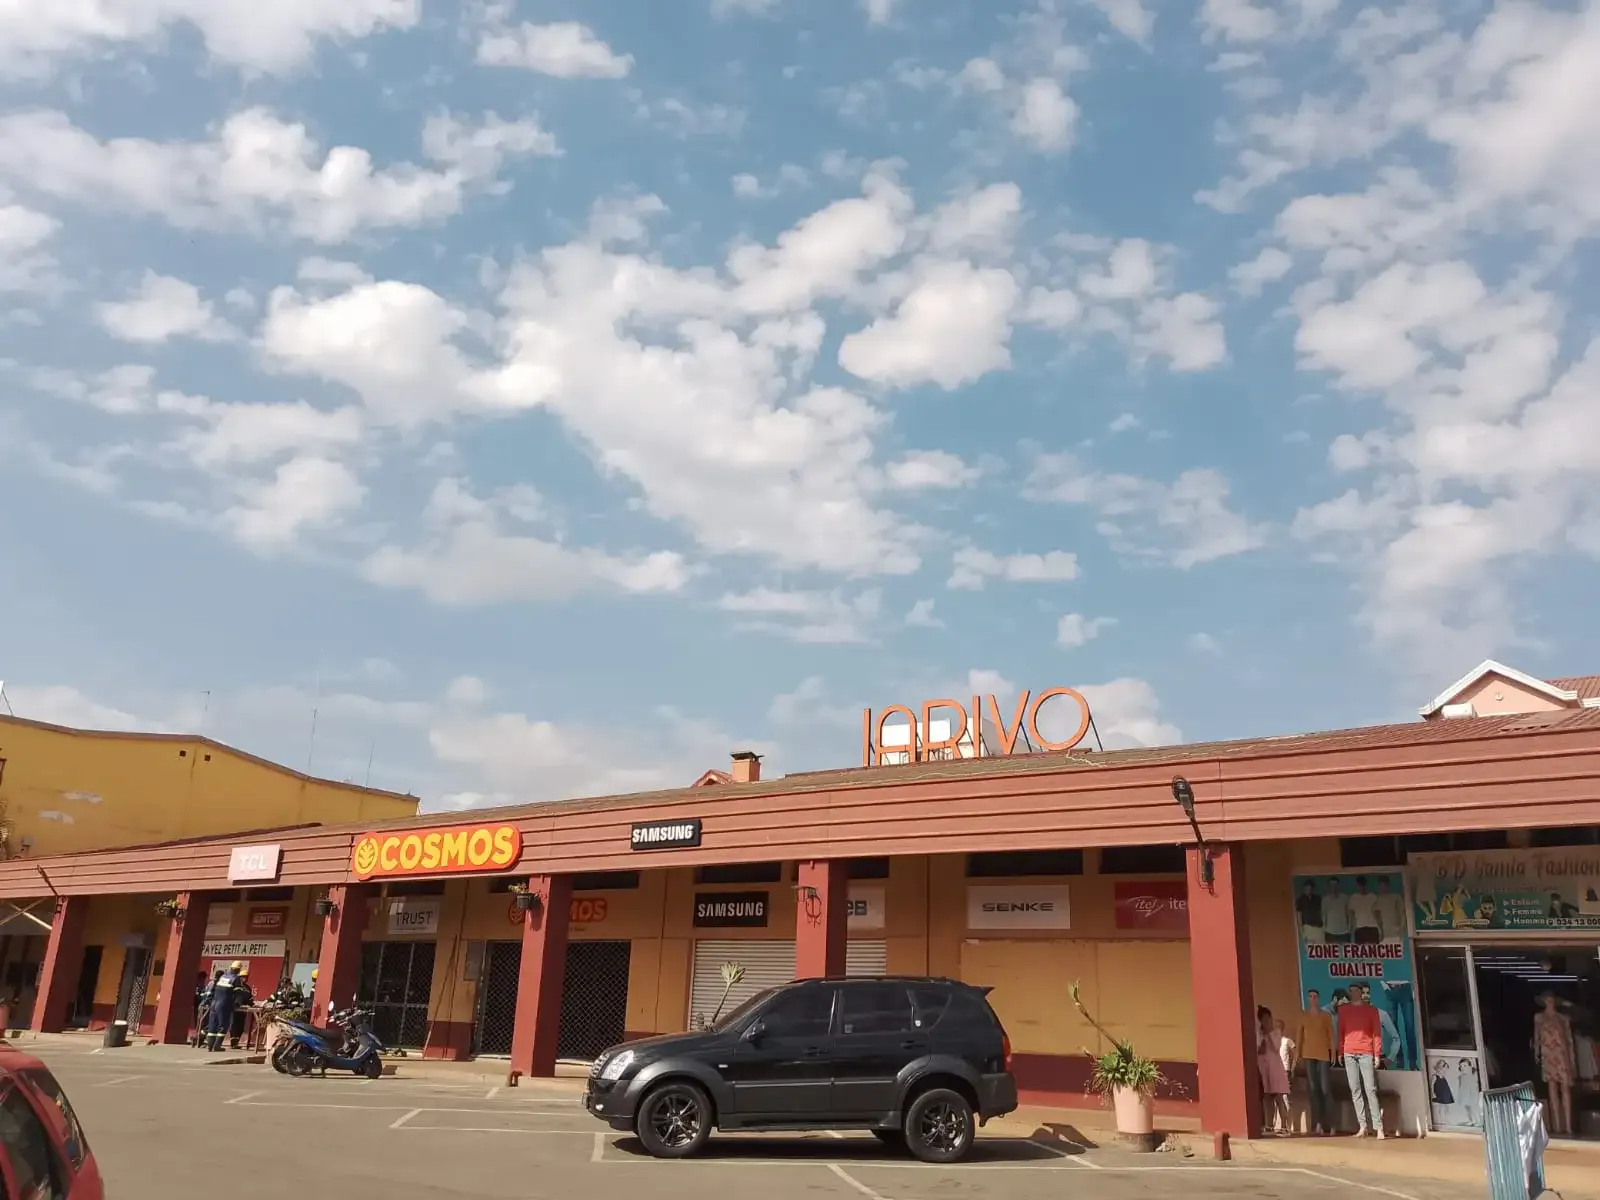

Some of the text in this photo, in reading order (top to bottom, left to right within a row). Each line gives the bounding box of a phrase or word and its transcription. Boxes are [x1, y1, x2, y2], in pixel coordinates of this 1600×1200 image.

[862, 686, 1091, 767] IARIVO
[631, 824, 694, 843] SAMSUNG
[380, 826, 514, 870] COSMOS
[240, 854, 267, 872] TCL
[697, 901, 764, 918] SAMSUNG
[982, 902, 1054, 913] SENKE
[1169, 897, 1187, 910] ite
[396, 911, 433, 926] TRUST
[201, 944, 222, 955] PAYEZ
[223, 944, 241, 955] PETIT
[249, 943, 268, 955] PETIT
[1307, 943, 1403, 959] ZONE FRANCHE
